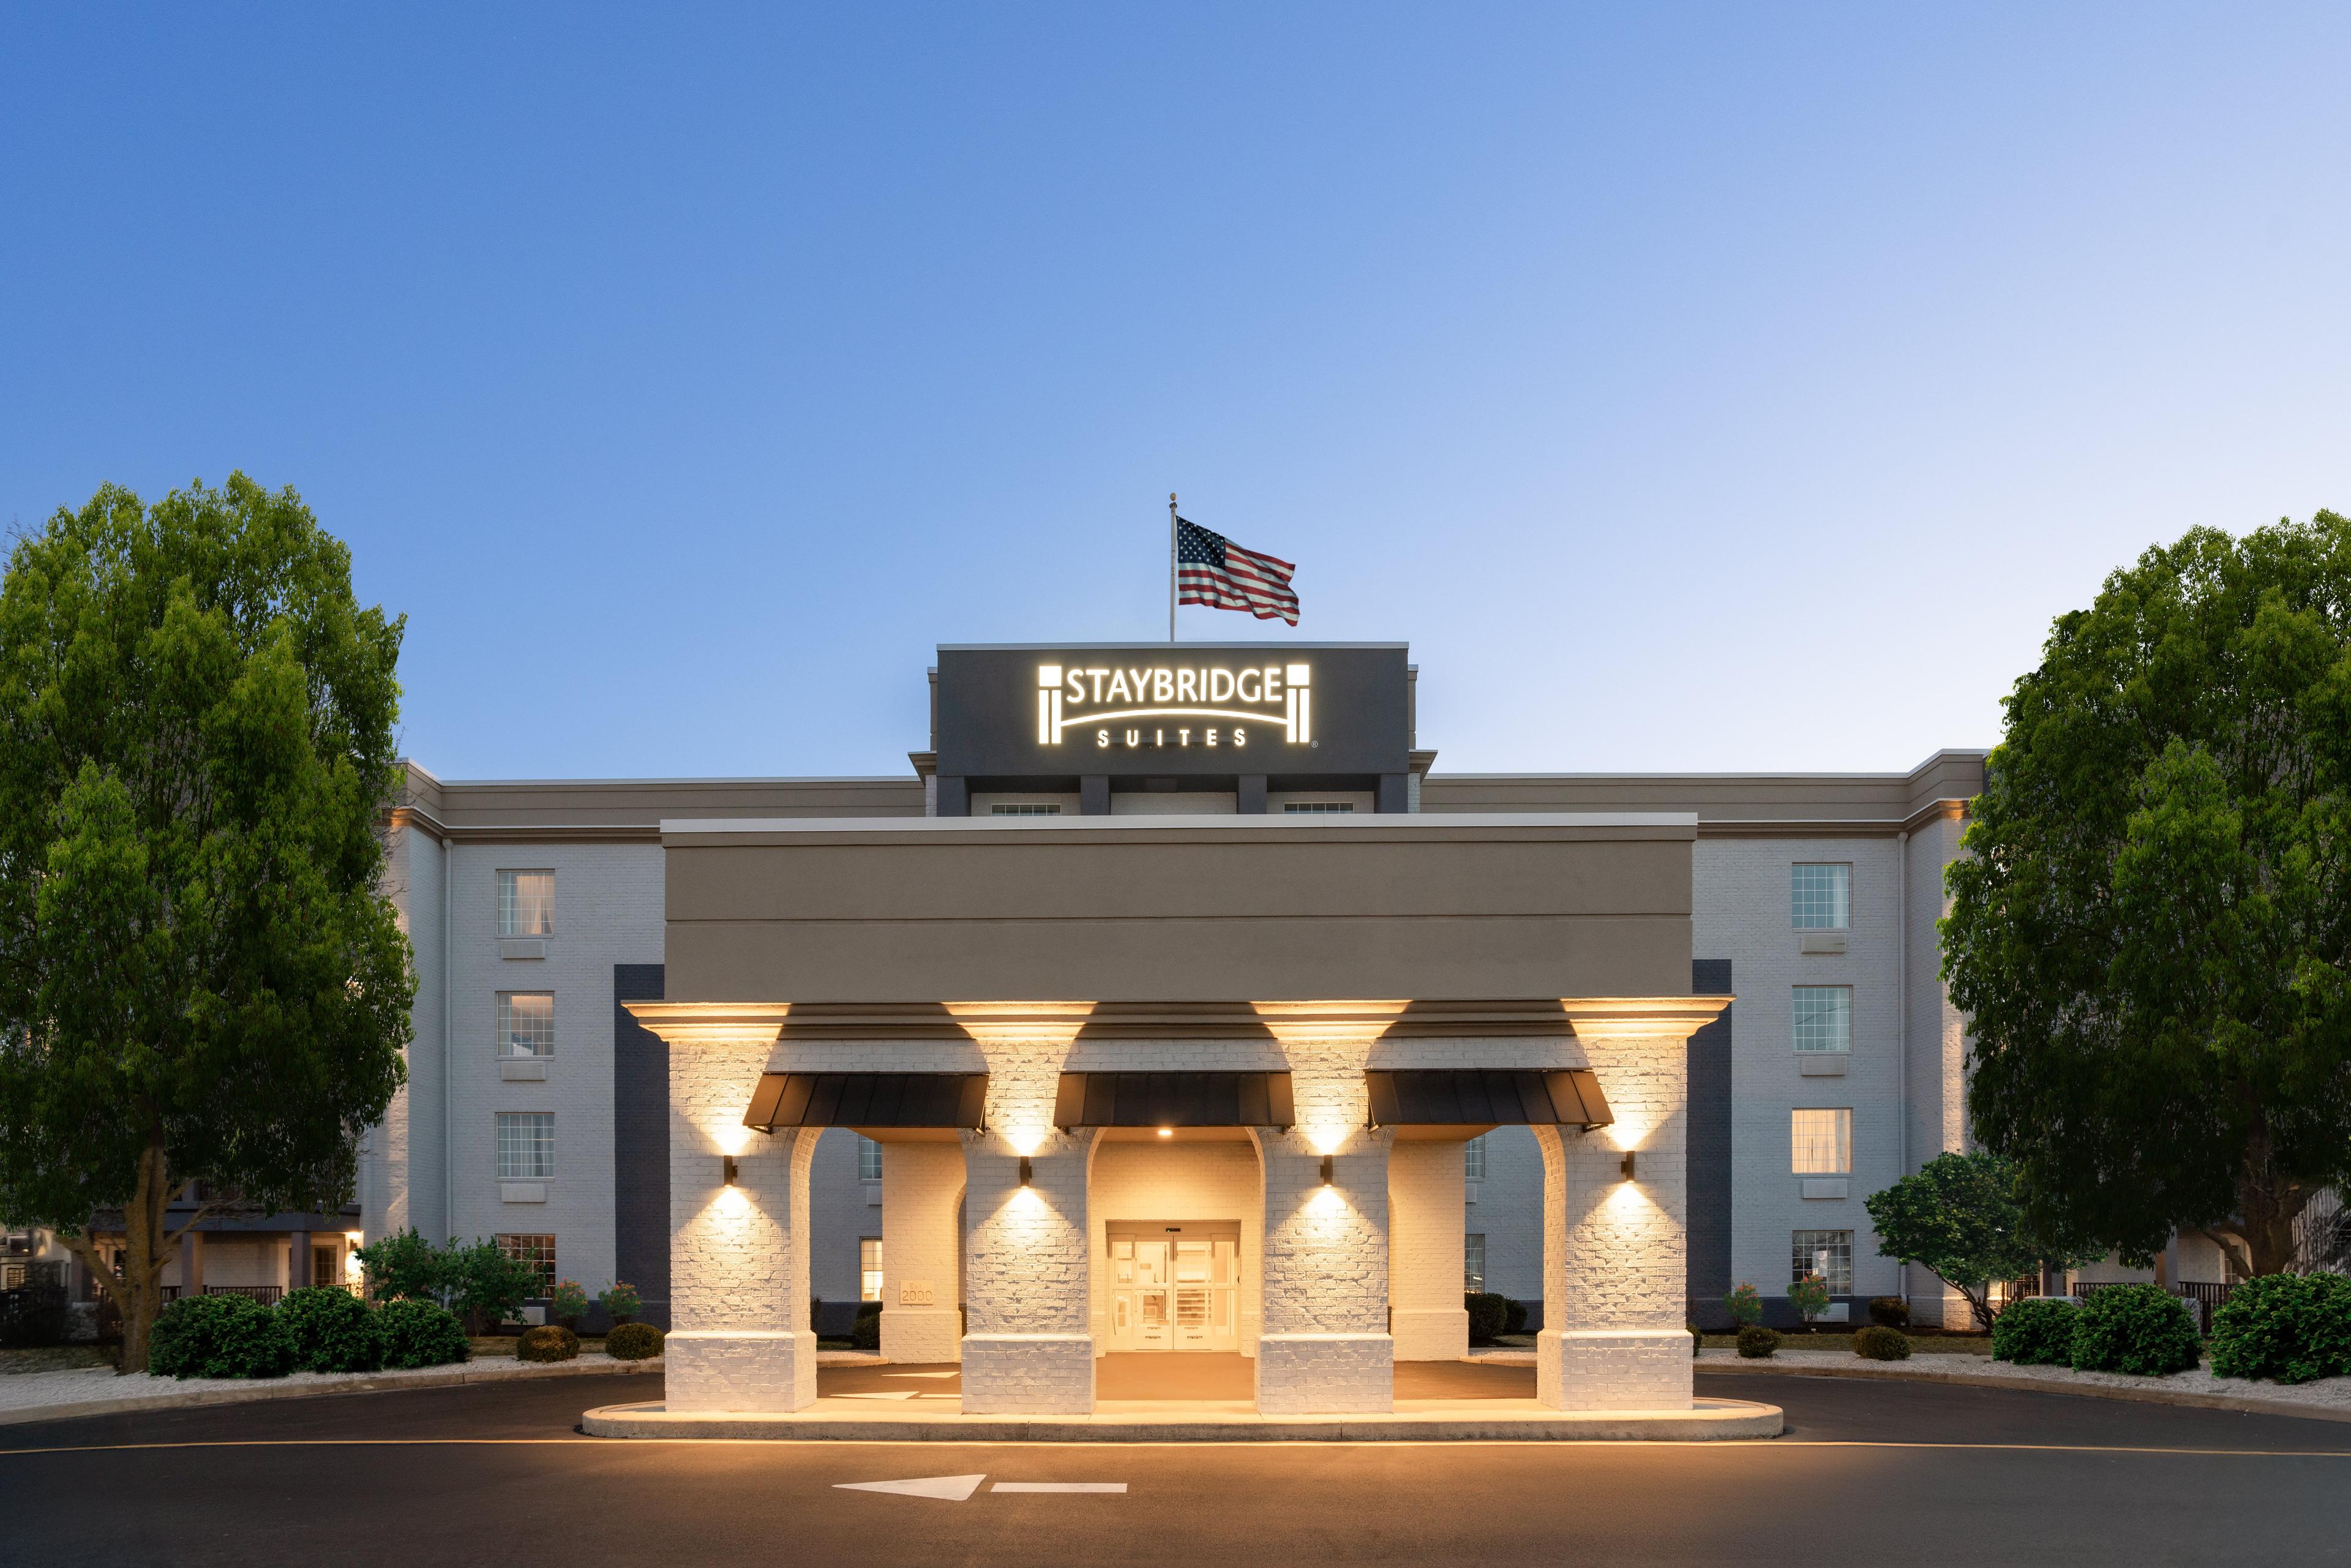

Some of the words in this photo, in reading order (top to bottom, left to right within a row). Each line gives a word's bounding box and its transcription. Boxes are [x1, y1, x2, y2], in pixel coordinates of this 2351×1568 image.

[1067, 668, 1282, 703] STAYBRIDGE
[1098, 729, 1245, 747] SUITES
[902, 1290, 932, 1301] 2000
